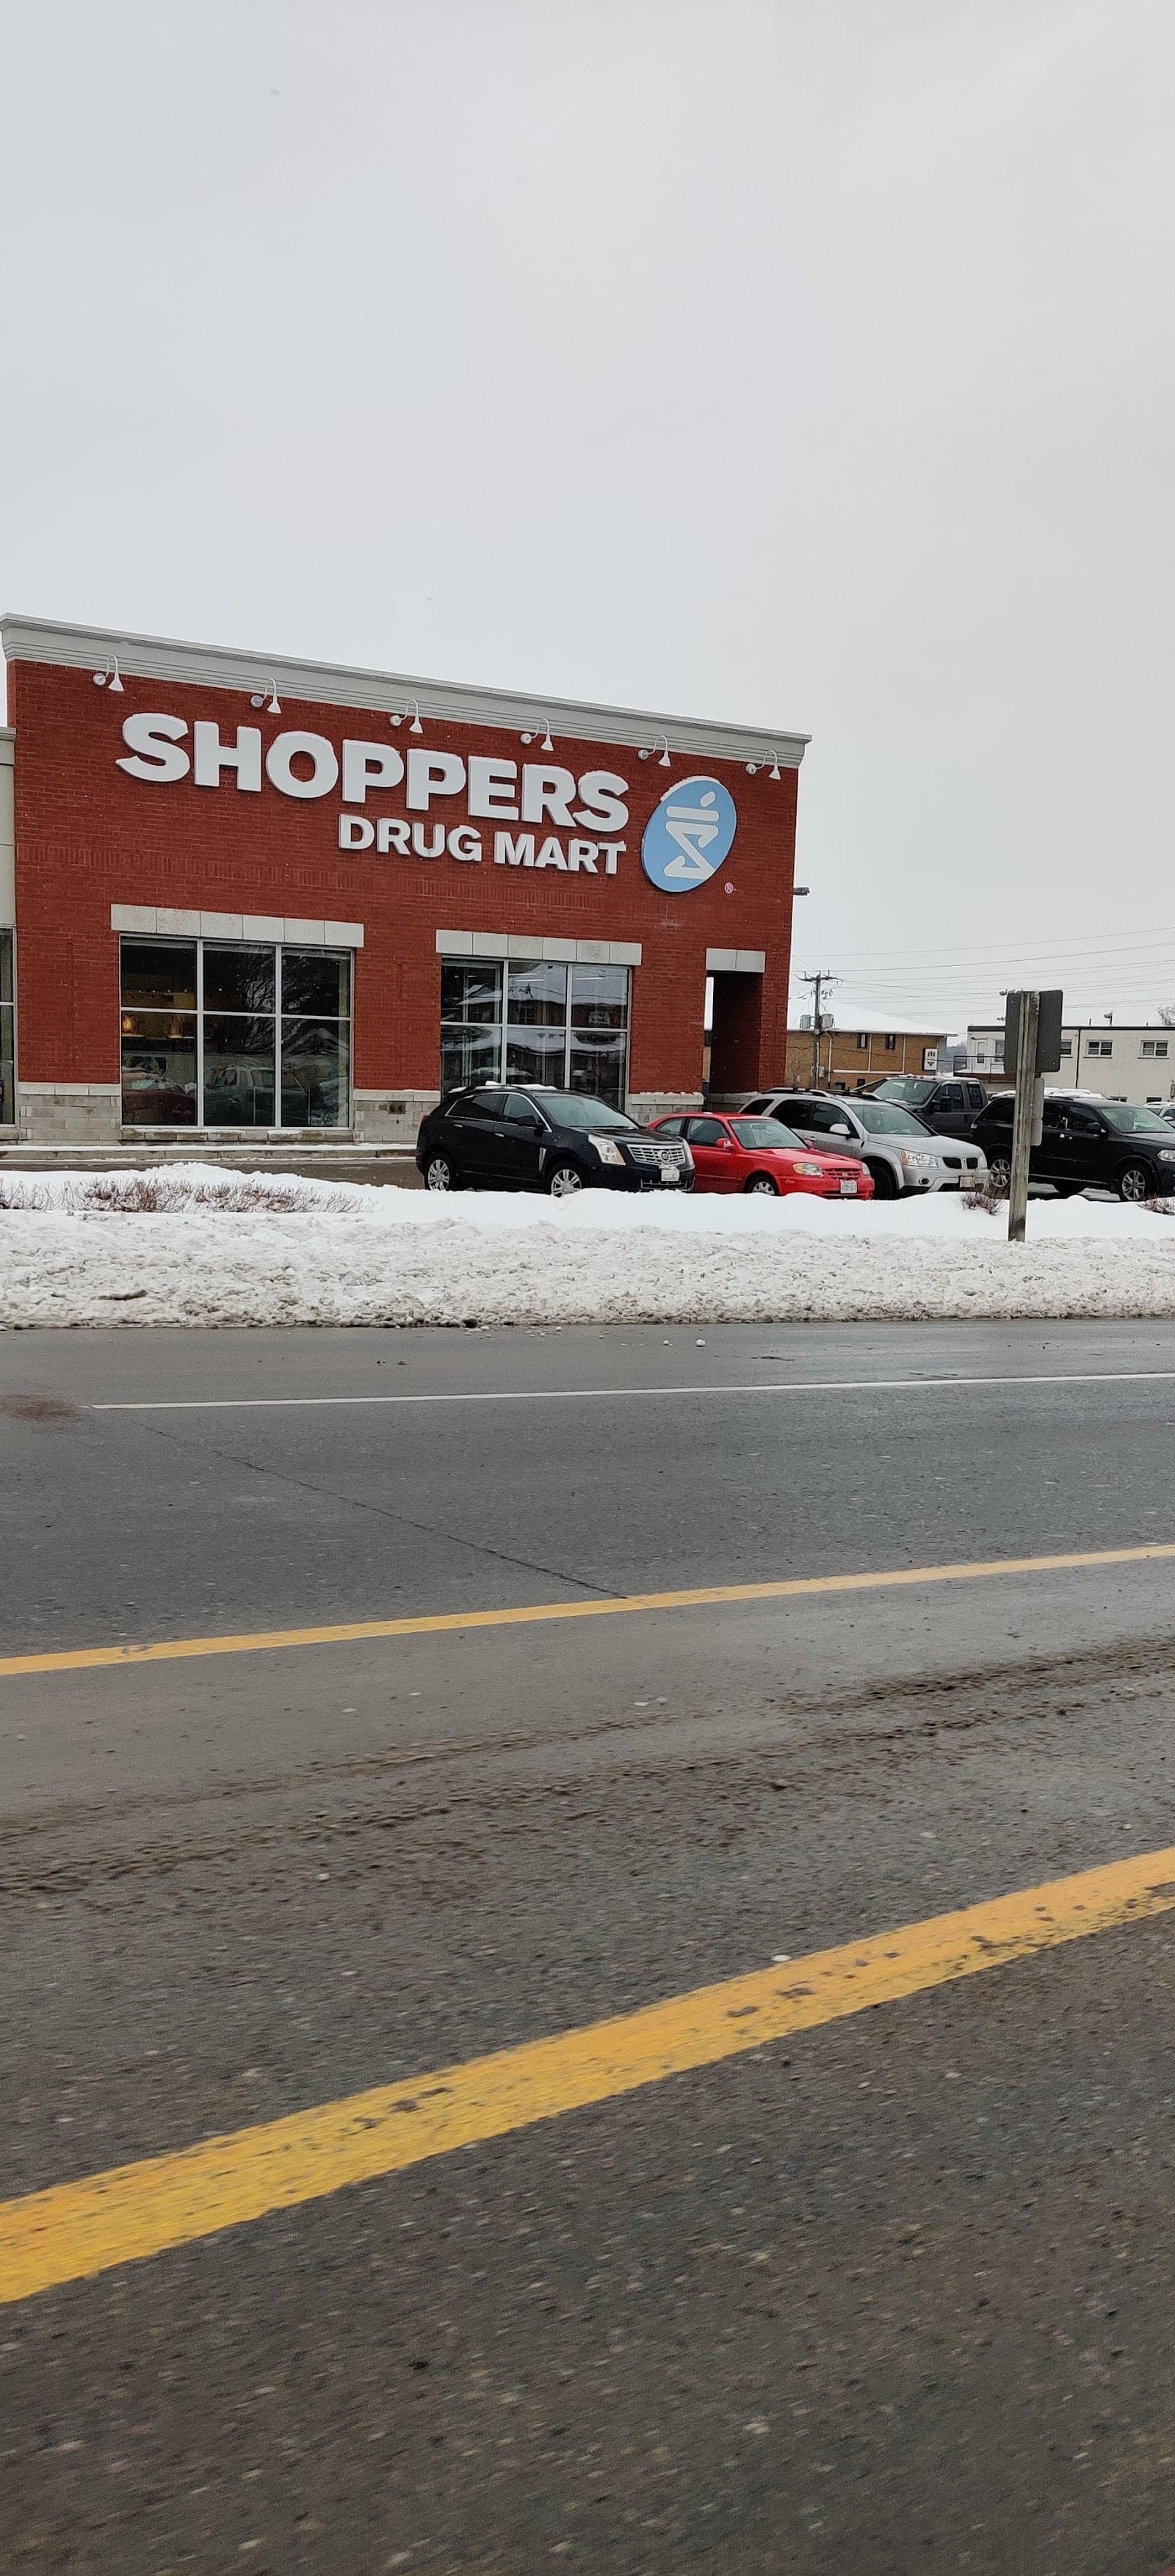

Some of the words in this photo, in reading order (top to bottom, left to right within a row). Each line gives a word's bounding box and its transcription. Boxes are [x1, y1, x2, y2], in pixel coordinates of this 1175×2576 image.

[115, 712, 629, 832] SHOPPERS
[339, 813, 482, 862] DRUG
[494, 831, 626, 874] MART
